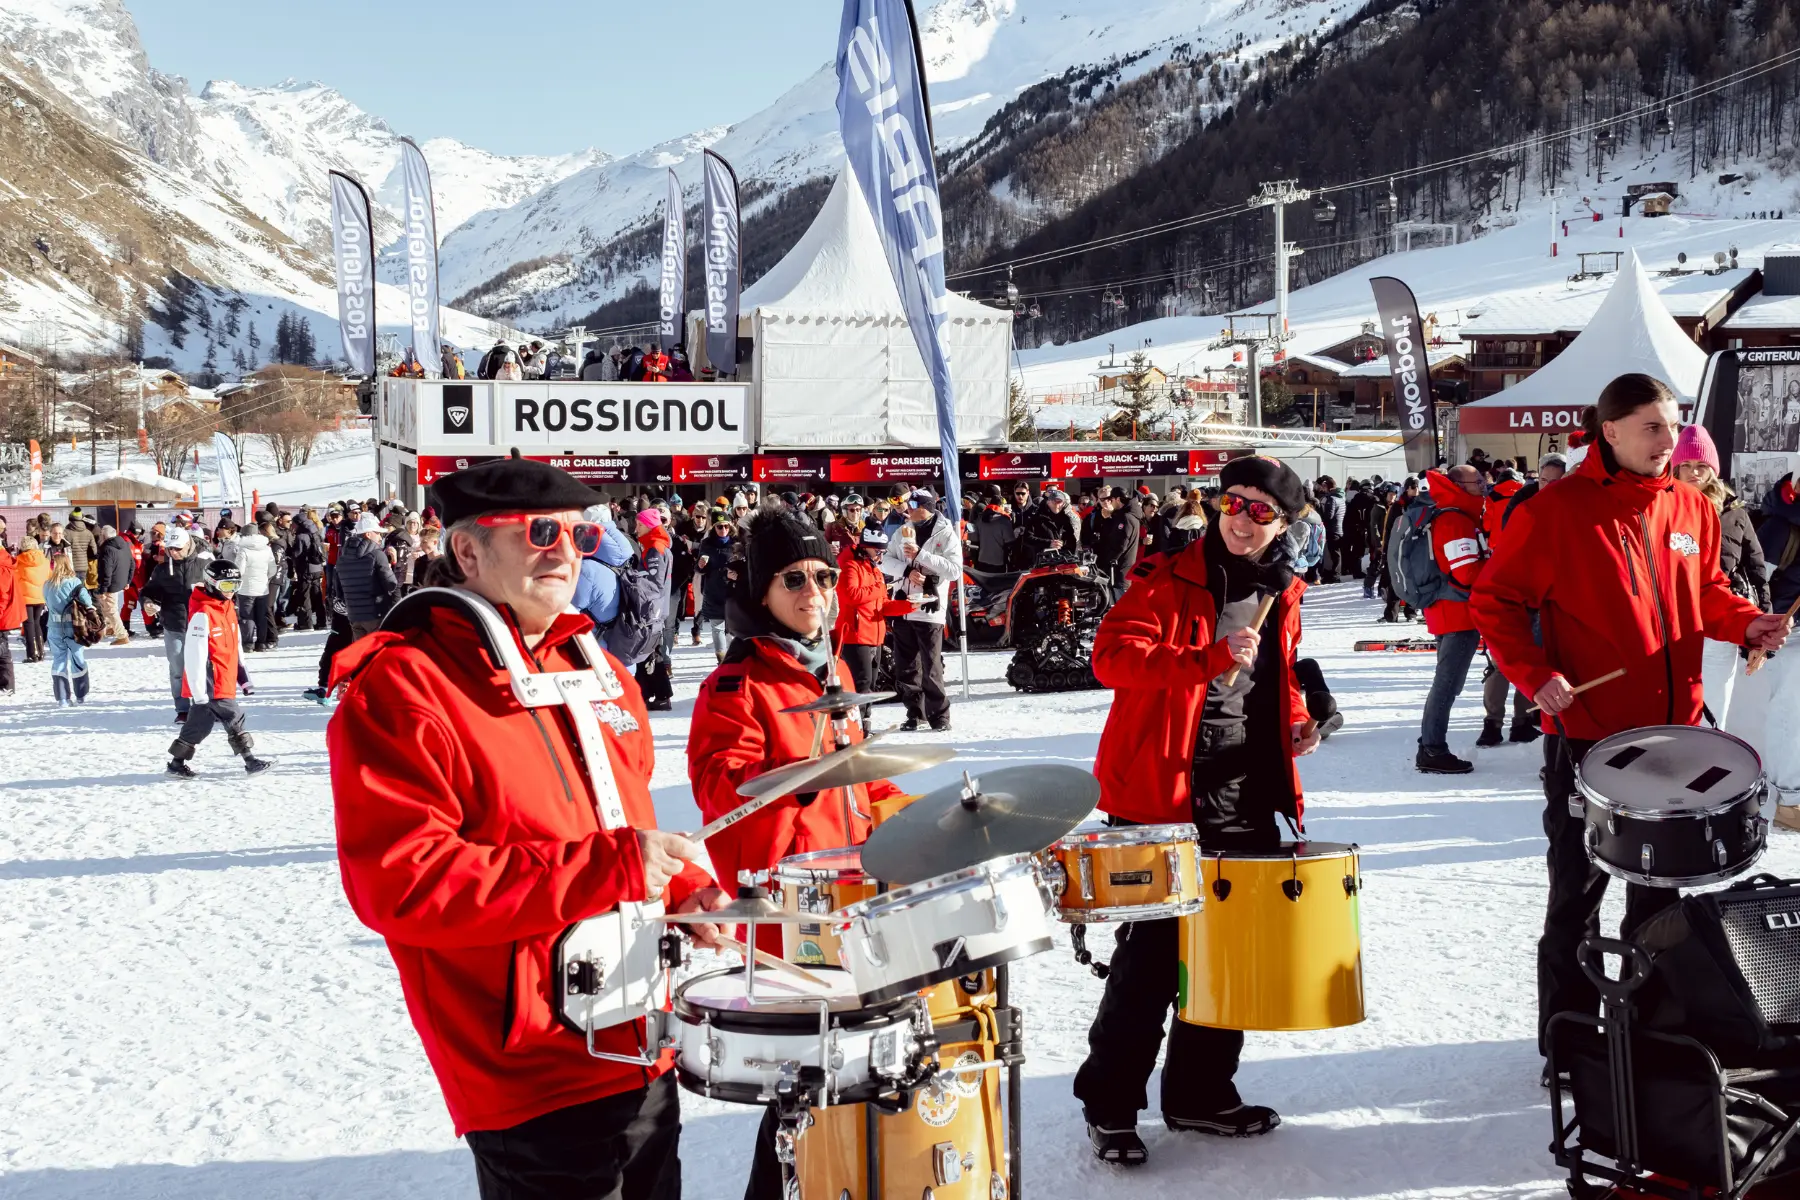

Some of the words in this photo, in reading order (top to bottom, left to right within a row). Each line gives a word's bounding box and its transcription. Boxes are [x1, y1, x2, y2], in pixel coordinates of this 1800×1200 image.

[1748, 350, 1800, 362] CRITERIU
[1509, 411, 1535, 428] LA
[550, 459, 571, 468] BAR
[573, 458, 631, 468] CARLSBERG
[870, 457, 888, 466] BAR
[891, 457, 942, 466] CARLSBERG
[1064, 453, 1098, 464] HUÎTRES
[1104, 454, 1133, 463] SNACK
[1139, 453, 1178, 463] RACLETTE
[1766, 911, 1800, 930] CU
